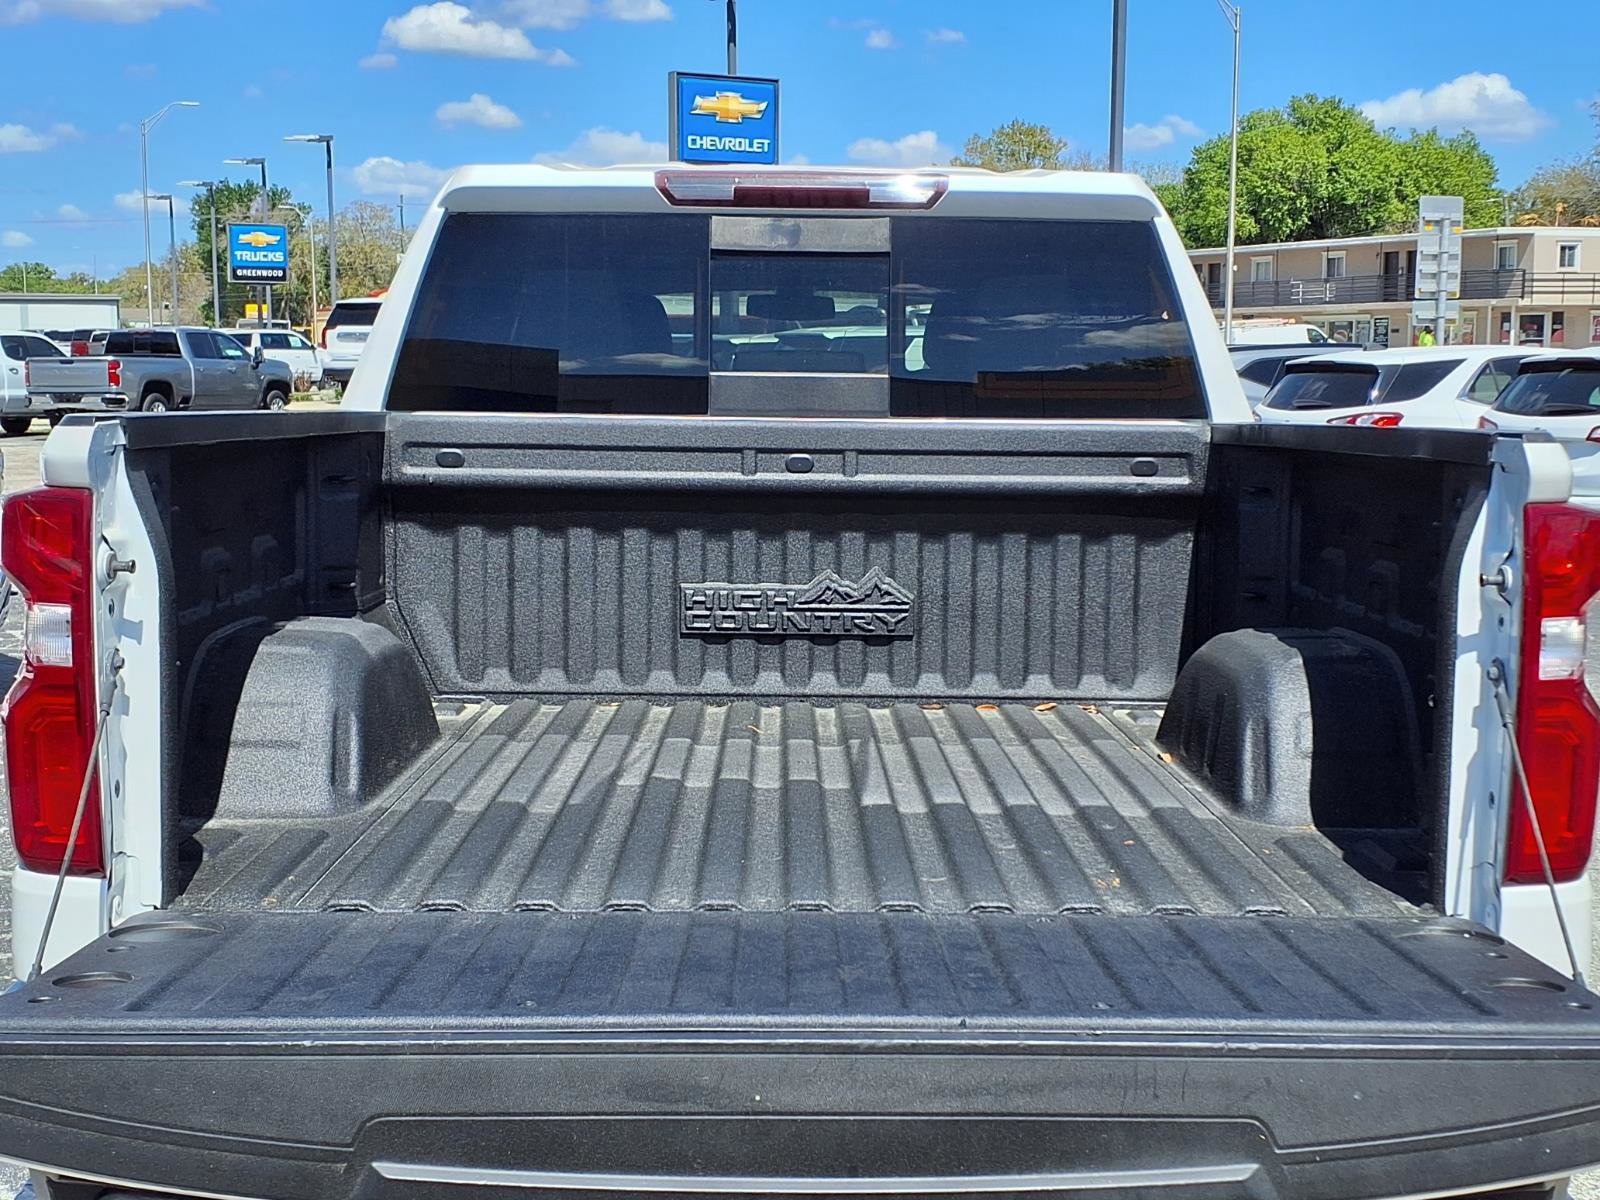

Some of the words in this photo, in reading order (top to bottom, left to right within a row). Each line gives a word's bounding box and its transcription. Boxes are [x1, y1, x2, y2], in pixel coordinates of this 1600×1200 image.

[687, 135, 771, 152] CHEVROLET
[234, 250, 284, 262] TRUCKS
[236, 269, 283, 277] GREENWOOD
[685, 590, 796, 610] HIGH
[685, 610, 910, 632] COUNTRY
